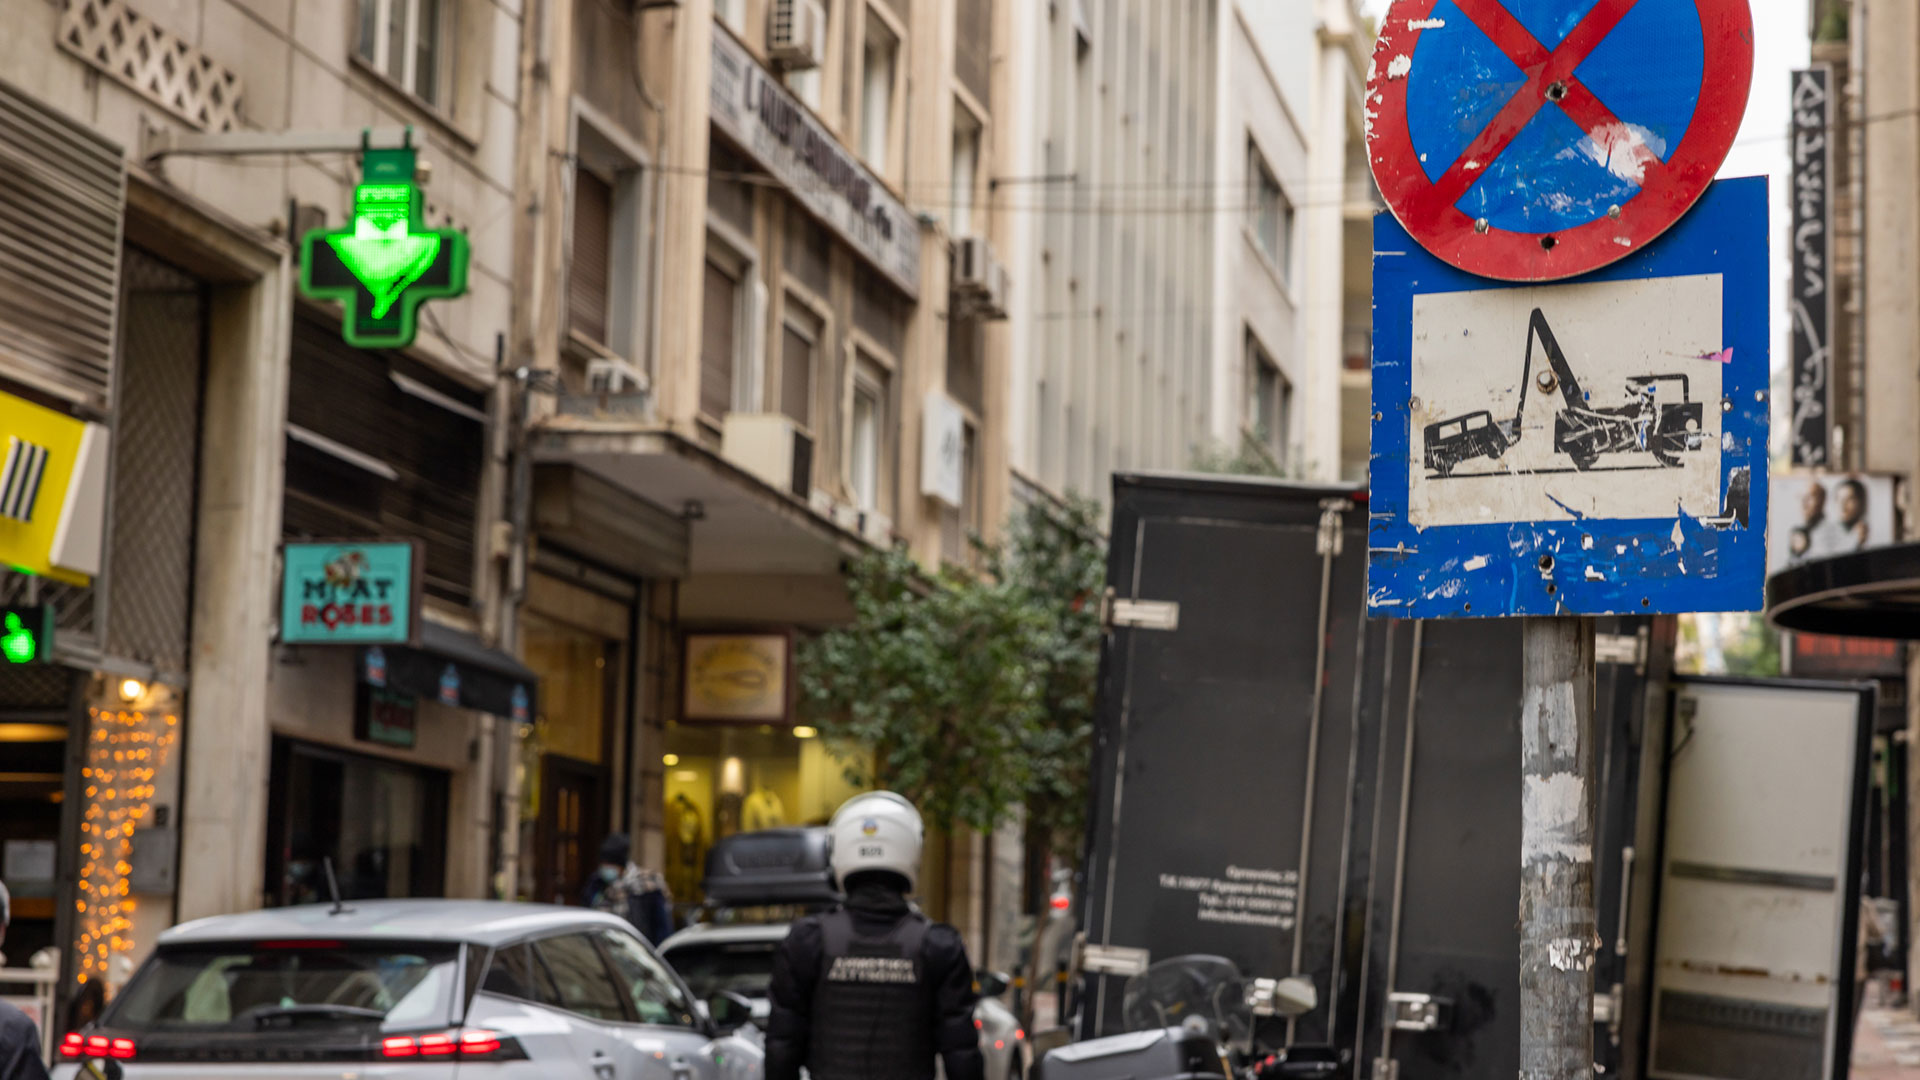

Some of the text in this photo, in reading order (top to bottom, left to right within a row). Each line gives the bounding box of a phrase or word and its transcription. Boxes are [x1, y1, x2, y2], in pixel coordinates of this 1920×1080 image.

[301, 603, 394, 631] ROSES
[833, 956, 914, 971] ΔΗΜΟΤΙΚΗ
[827, 969, 917, 983] ΑΣΤΥΝΟΜΙΑ
